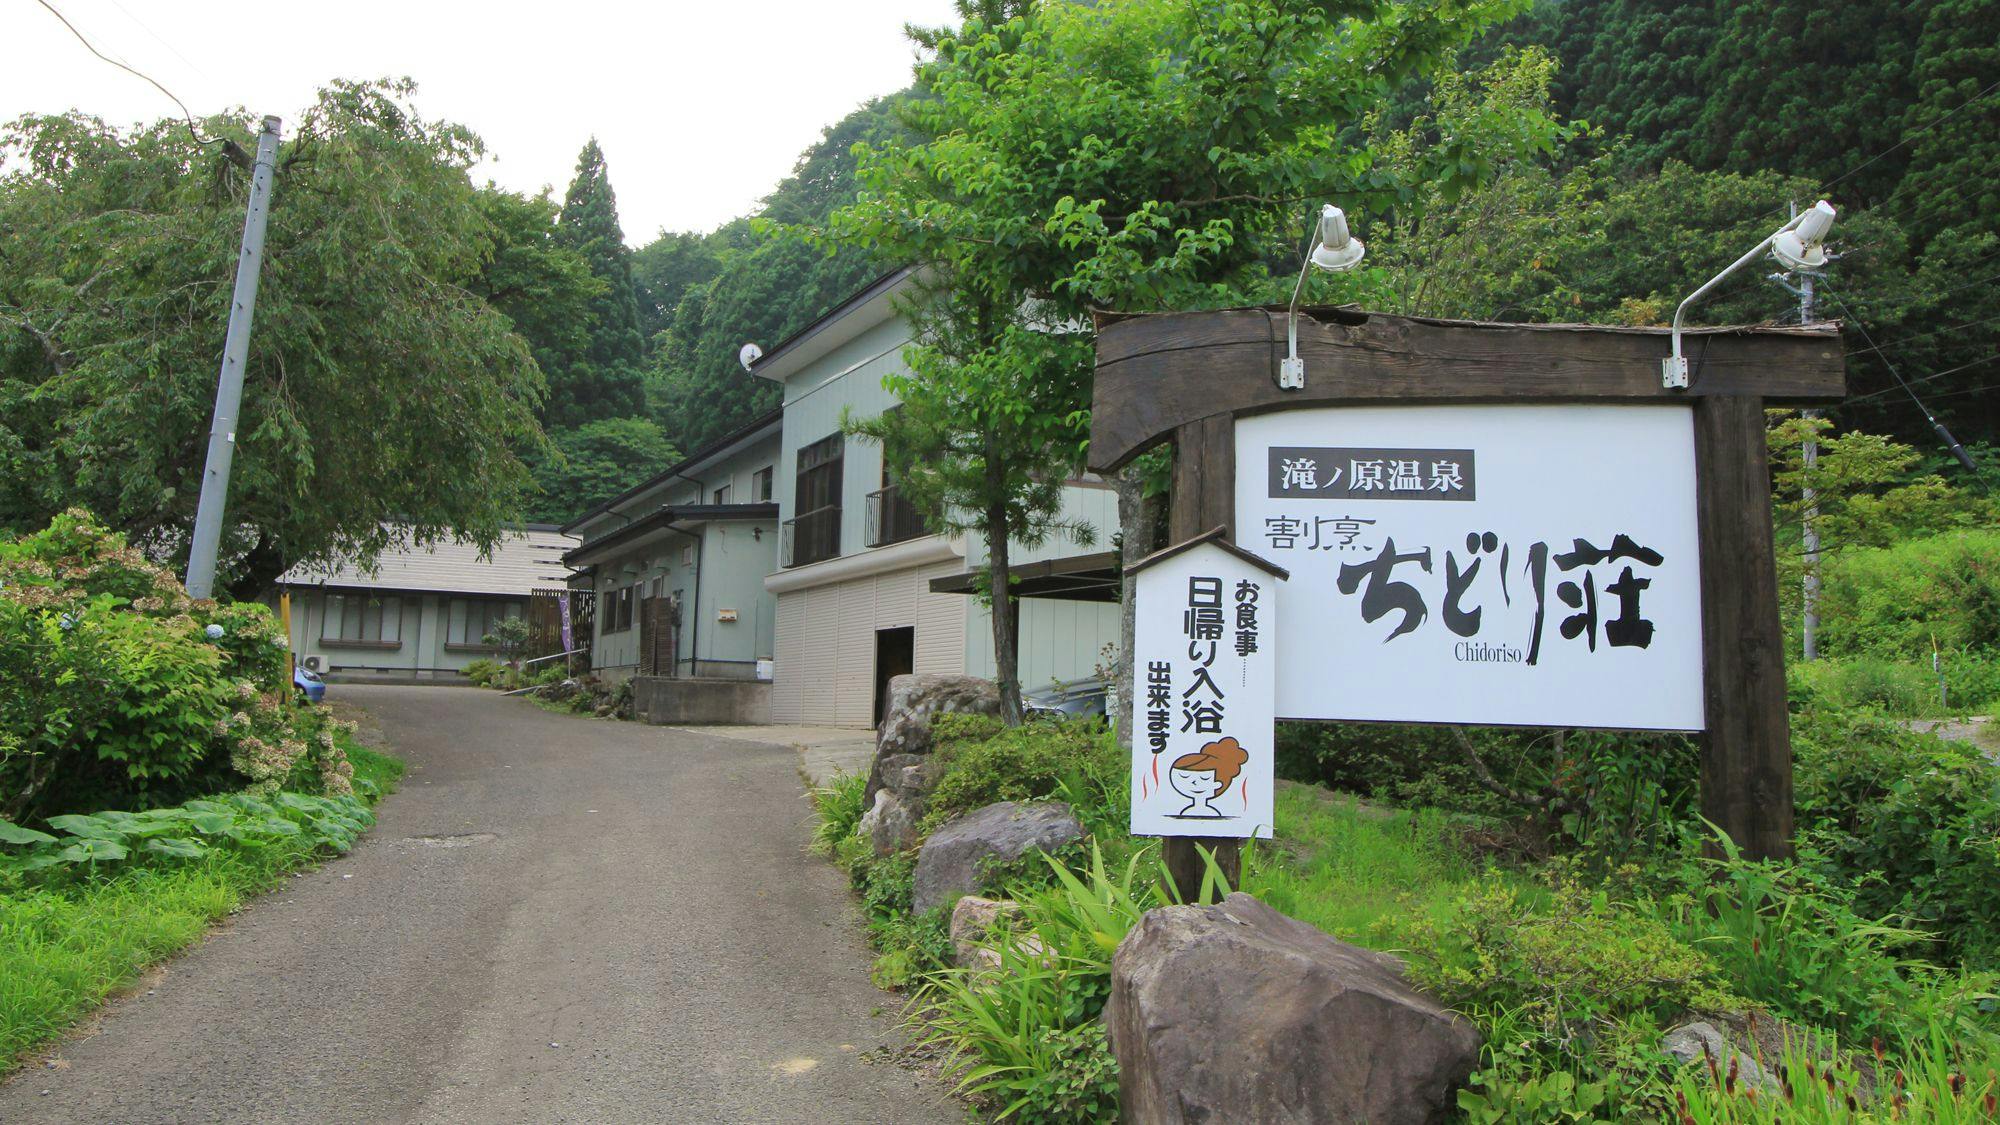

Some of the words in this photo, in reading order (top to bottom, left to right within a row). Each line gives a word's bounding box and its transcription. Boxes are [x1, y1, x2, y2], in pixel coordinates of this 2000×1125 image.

[1281, 457, 1464, 492] 滝ノ原温泉
[1264, 514, 1377, 551] 割烹
[1337, 531, 1665, 666] ちどり荘
[1180, 576, 1225, 734] 日帰り入浴
[1454, 642, 1522, 663] Chidoriso
[1146, 661, 1171, 755] 出来ます
